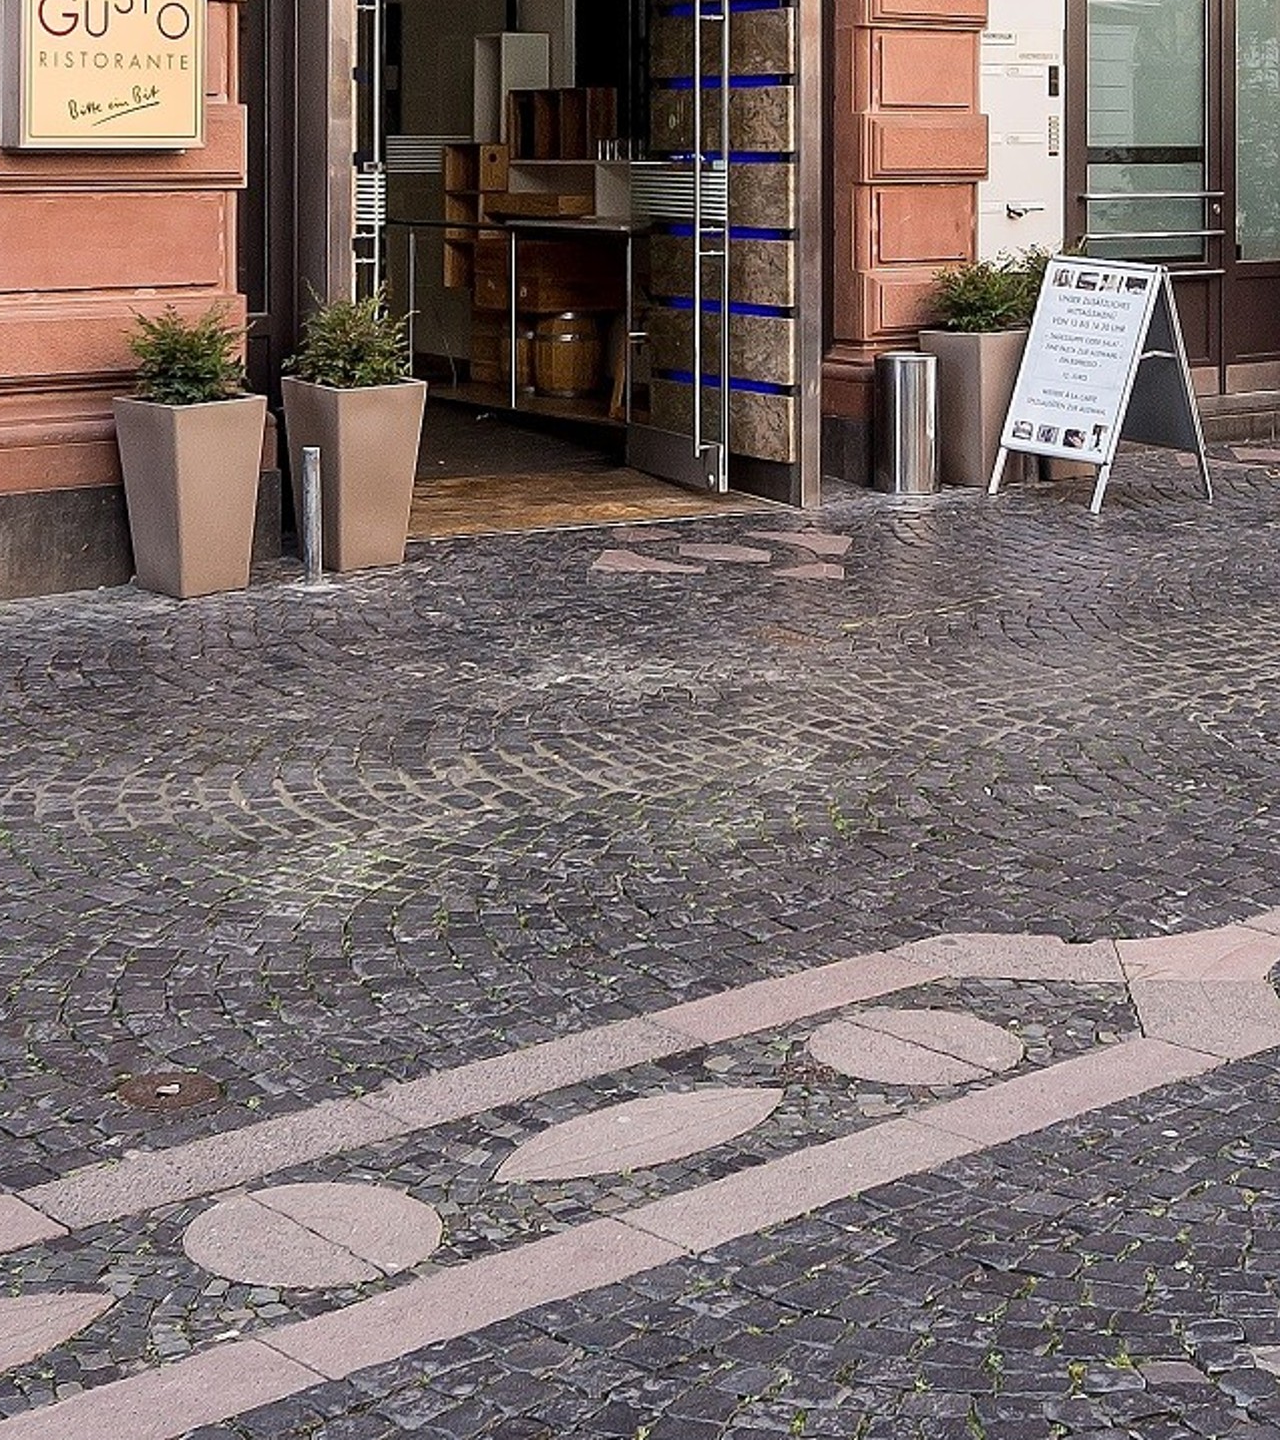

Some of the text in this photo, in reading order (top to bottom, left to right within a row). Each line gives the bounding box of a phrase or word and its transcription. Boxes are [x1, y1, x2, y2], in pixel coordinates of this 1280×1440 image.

[39, 50, 189, 71] RISTORANTE
[68, 84, 160, 120] Bitte ein Bit
